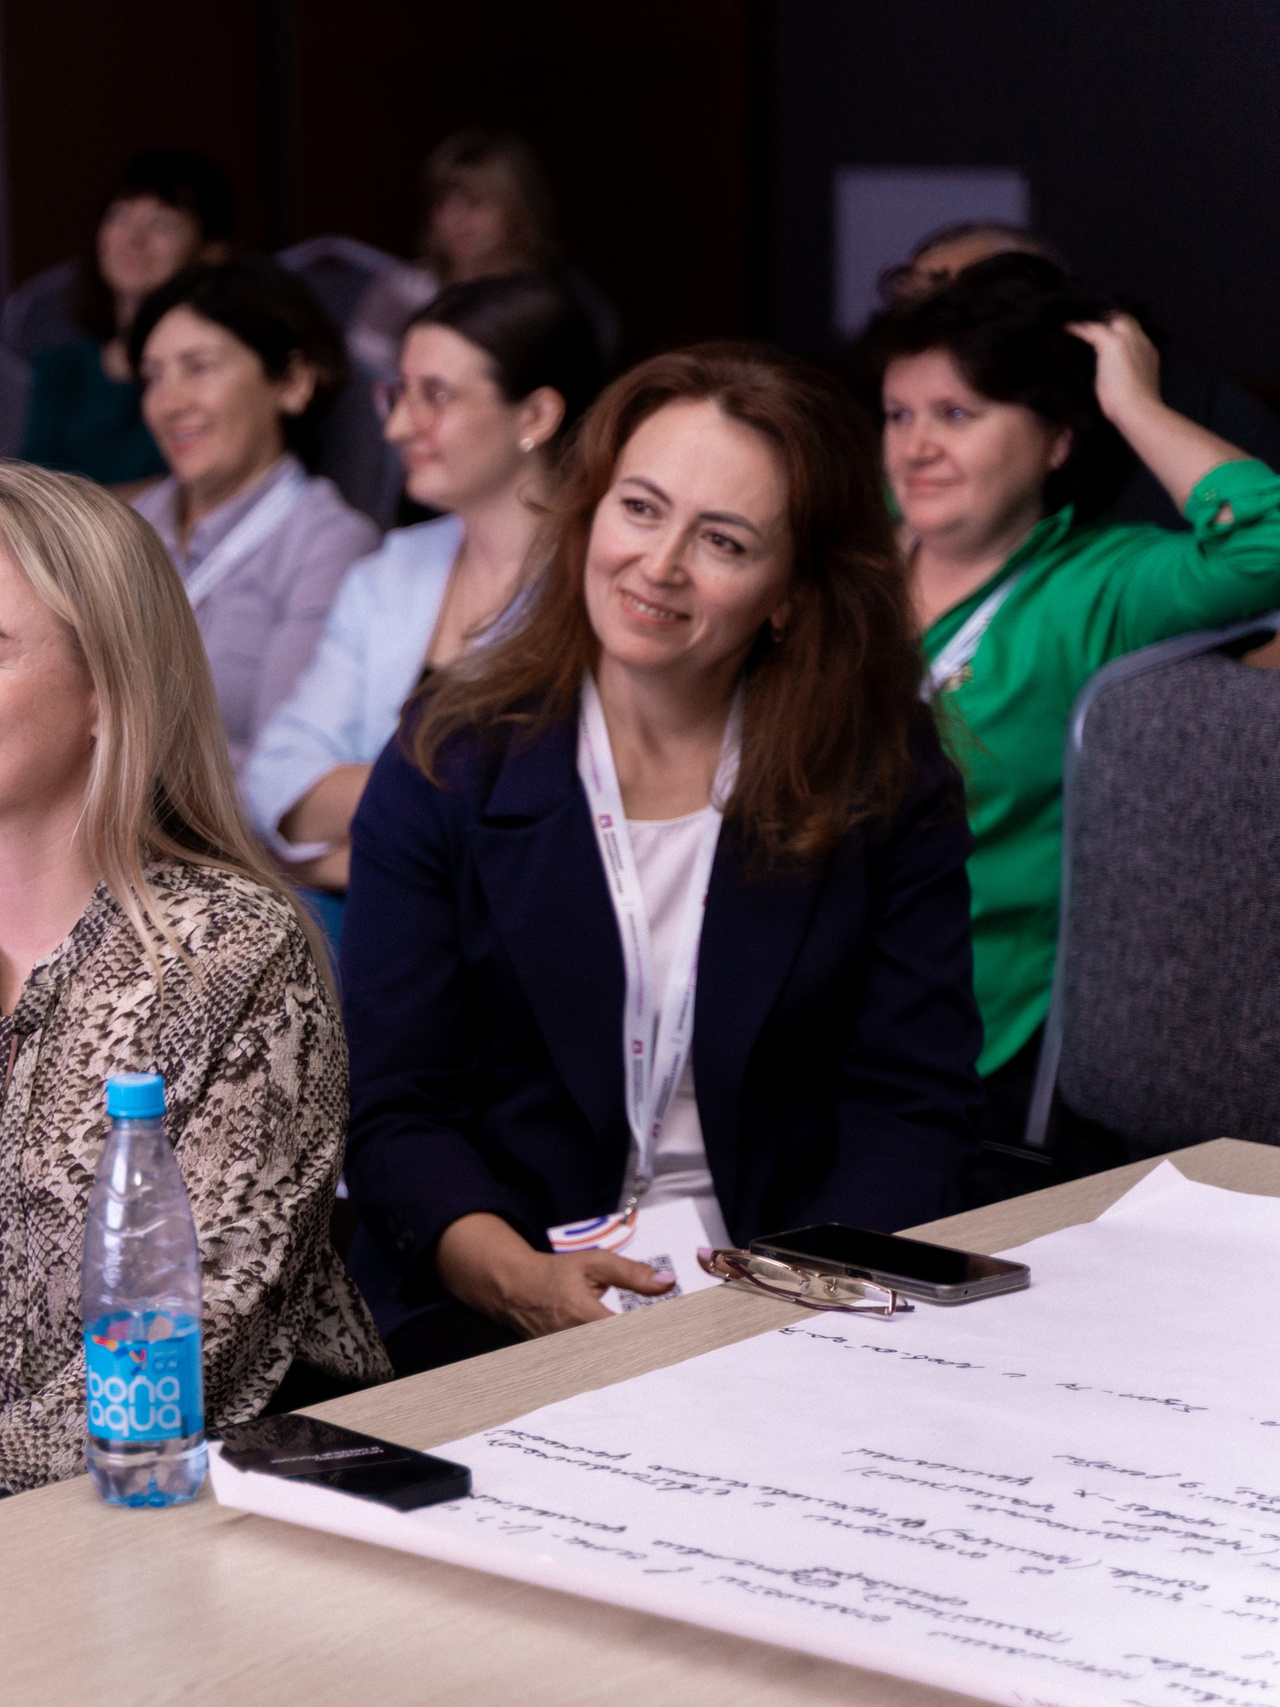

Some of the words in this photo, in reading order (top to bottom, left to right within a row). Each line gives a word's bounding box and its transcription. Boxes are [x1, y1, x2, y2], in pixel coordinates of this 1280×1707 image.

[1001, 1371, 1028, 1379] и
[88, 1365, 180, 1404] bona
[90, 1400, 182, 1437] aqua
[752, 1500, 777, 1509] и
[1177, 1546, 1216, 1557] об
[1014, 1564, 1056, 1576] об
